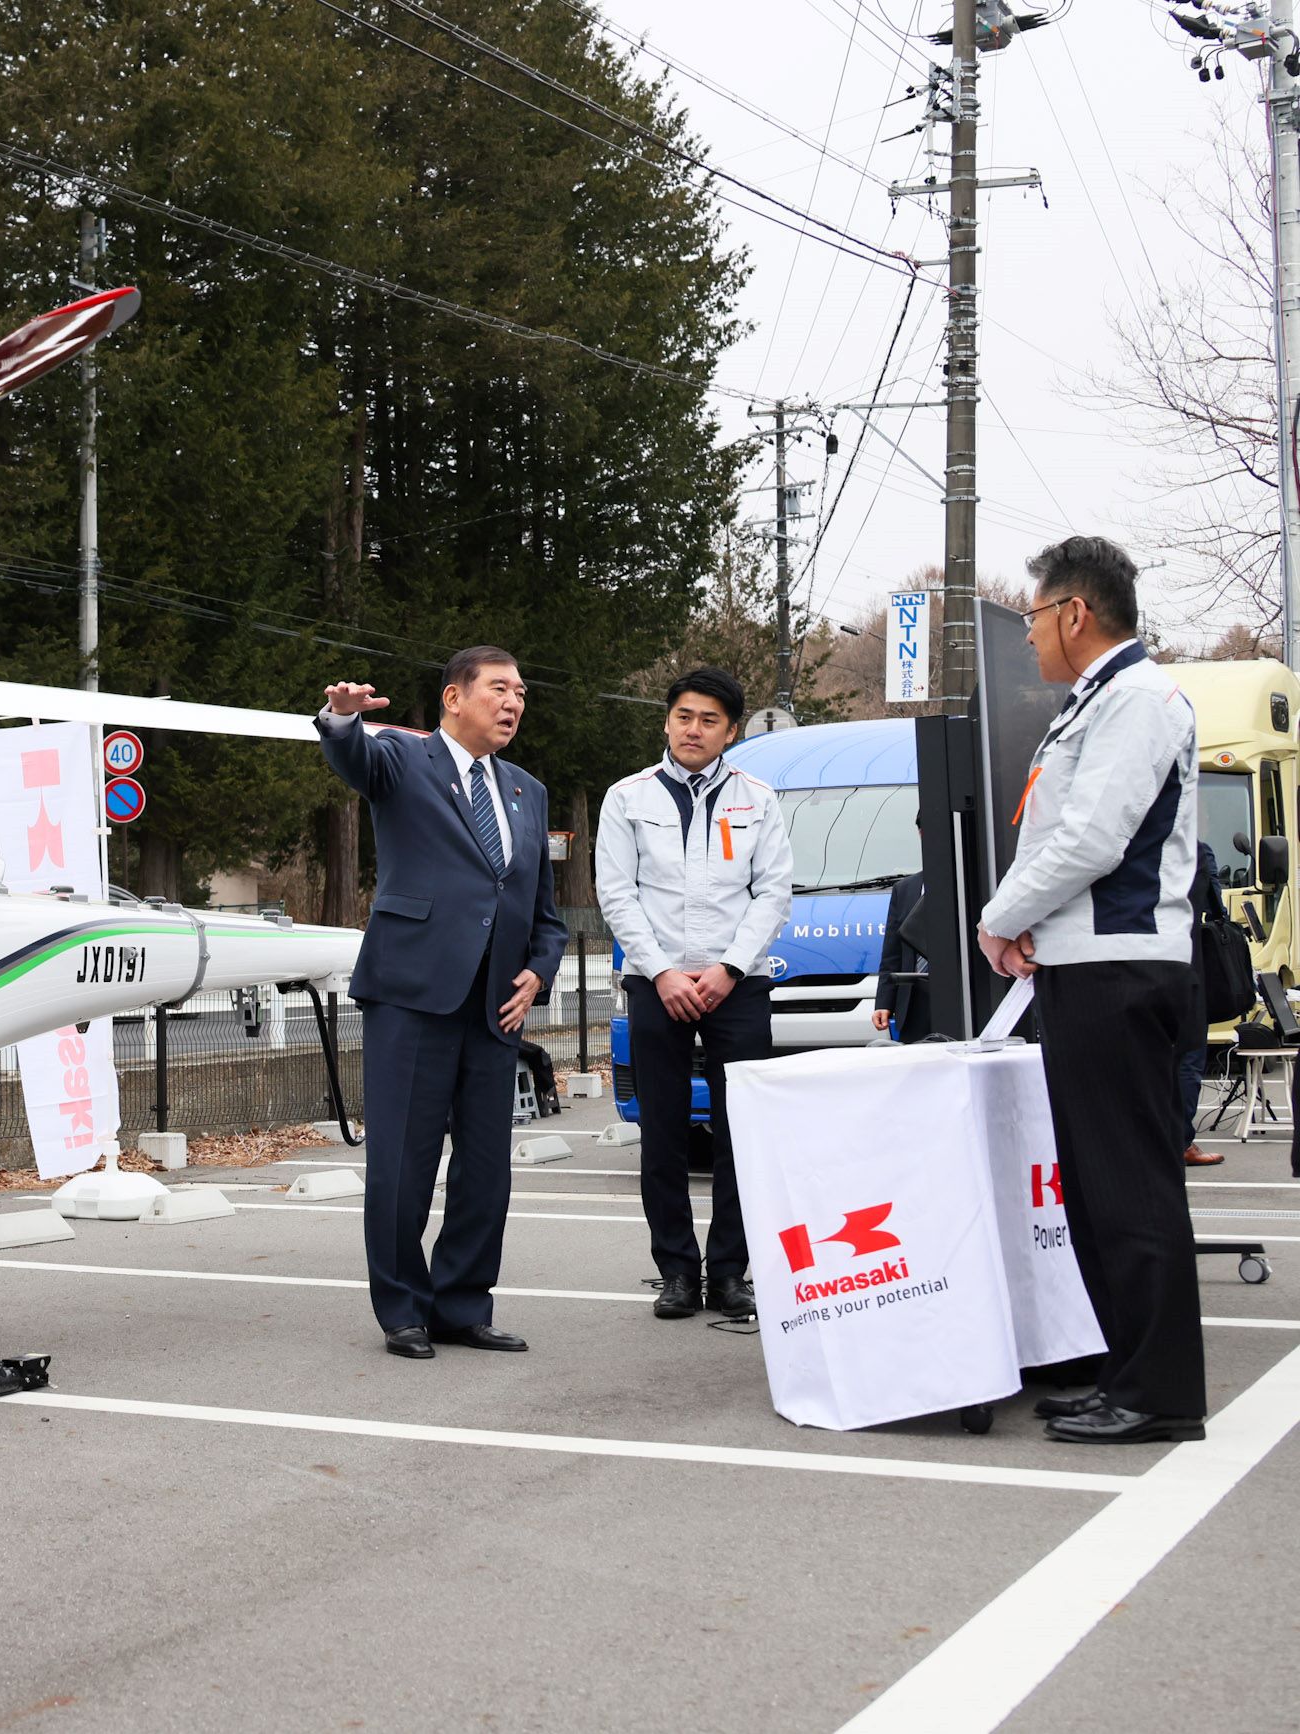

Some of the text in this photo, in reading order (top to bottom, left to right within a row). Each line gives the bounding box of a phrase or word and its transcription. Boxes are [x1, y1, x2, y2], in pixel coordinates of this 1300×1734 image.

[892, 593, 925, 606] NTN
[110, 743, 133, 763] 40
[794, 1257, 909, 1305] Kawasaki
[780, 1276, 949, 1334] Powering your potential
